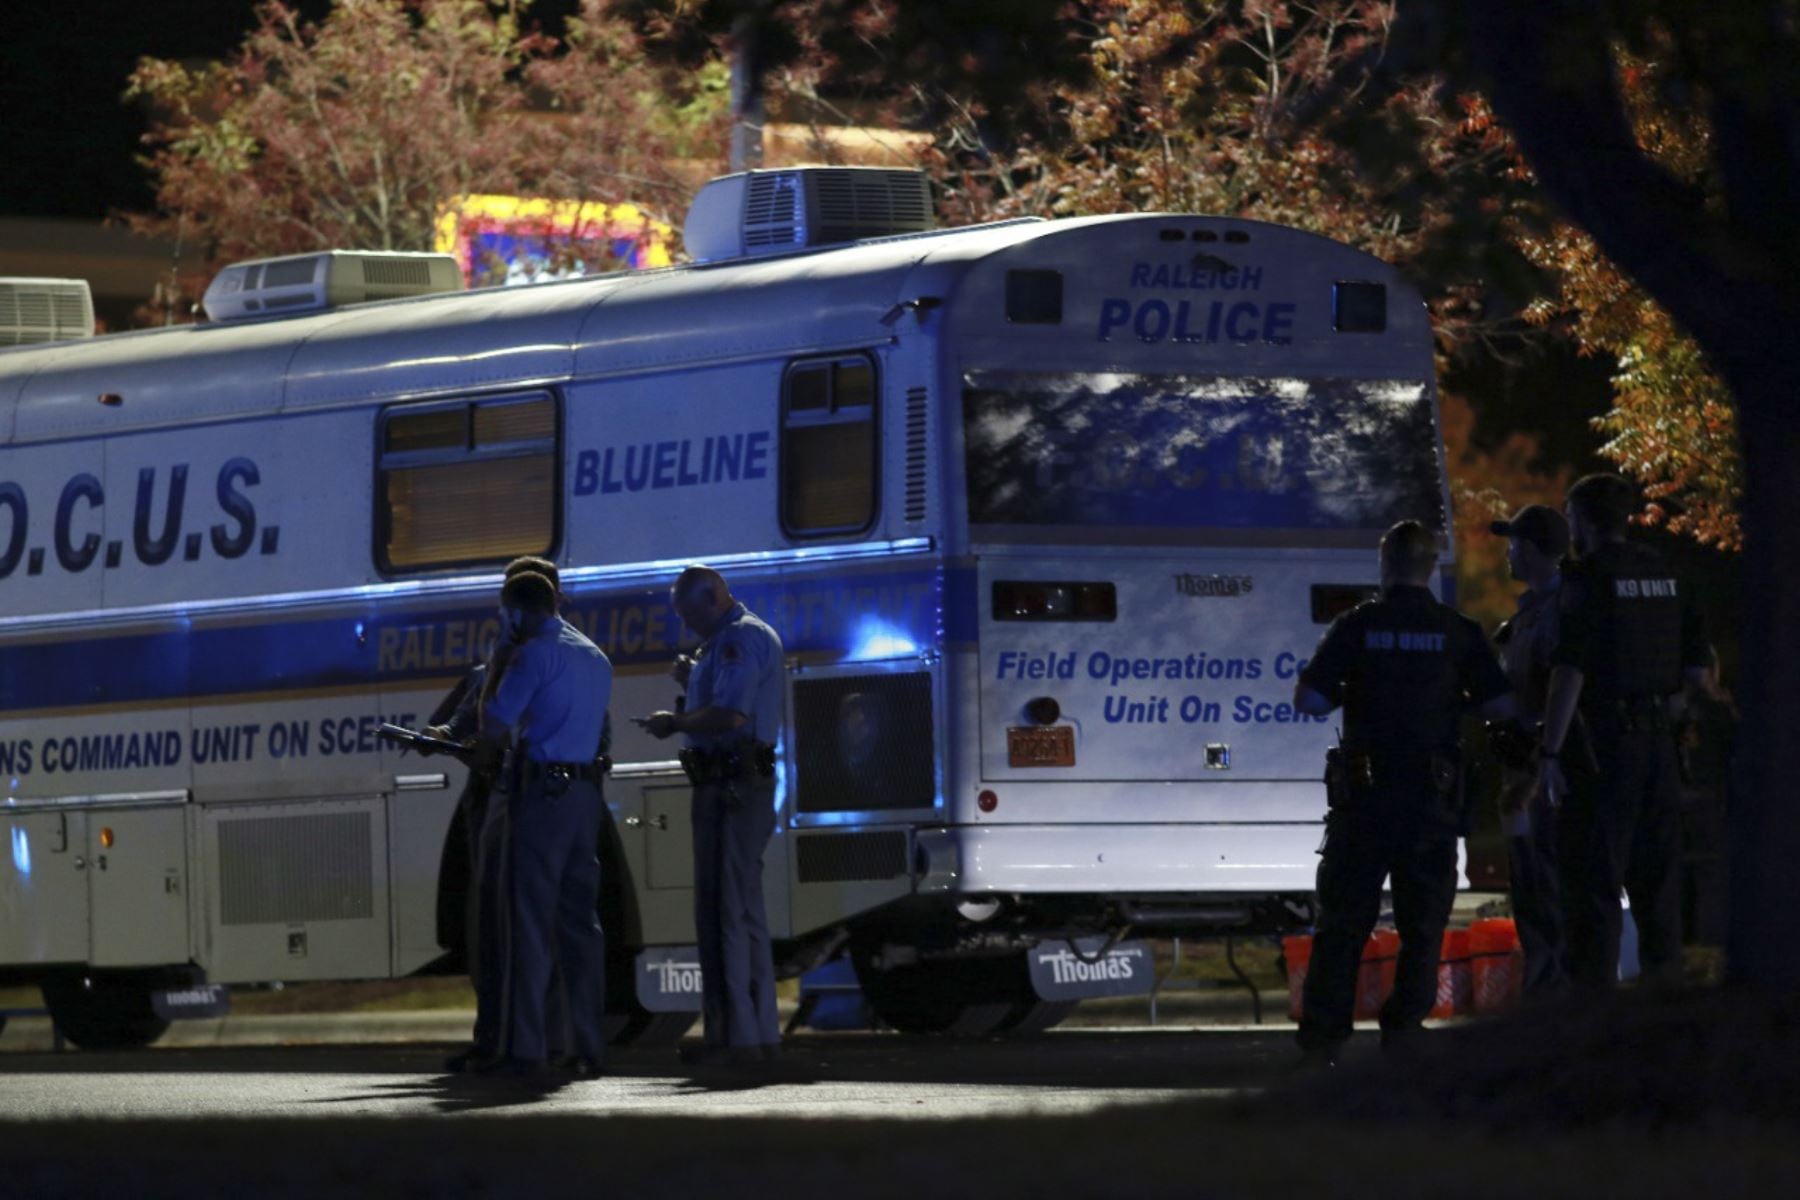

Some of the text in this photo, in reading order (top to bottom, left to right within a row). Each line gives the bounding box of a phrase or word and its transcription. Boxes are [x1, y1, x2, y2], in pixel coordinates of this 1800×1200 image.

[1130, 262, 1263, 290] RALEIGH
[1099, 298, 1297, 344] POLICE
[573, 431, 770, 497] BLUELINE
[1172, 573, 1254, 597] Thomas
[1615, 577, 1678, 599] K9 UNIT
[378, 617, 500, 672] RALEIG
[566, 604, 668, 655] LICE
[1398, 632, 1447, 652] UNIT
[997, 651, 1076, 680] Field
[1087, 651, 1262, 685] Operations
[1104, 696, 1168, 724] Unit
[1180, 696, 1222, 724] On
[41, 730, 182, 773] COMMAND
[191, 724, 260, 765] UNIT
[269, 719, 309, 759] ON
[1038, 948, 1143, 984] Thomas
